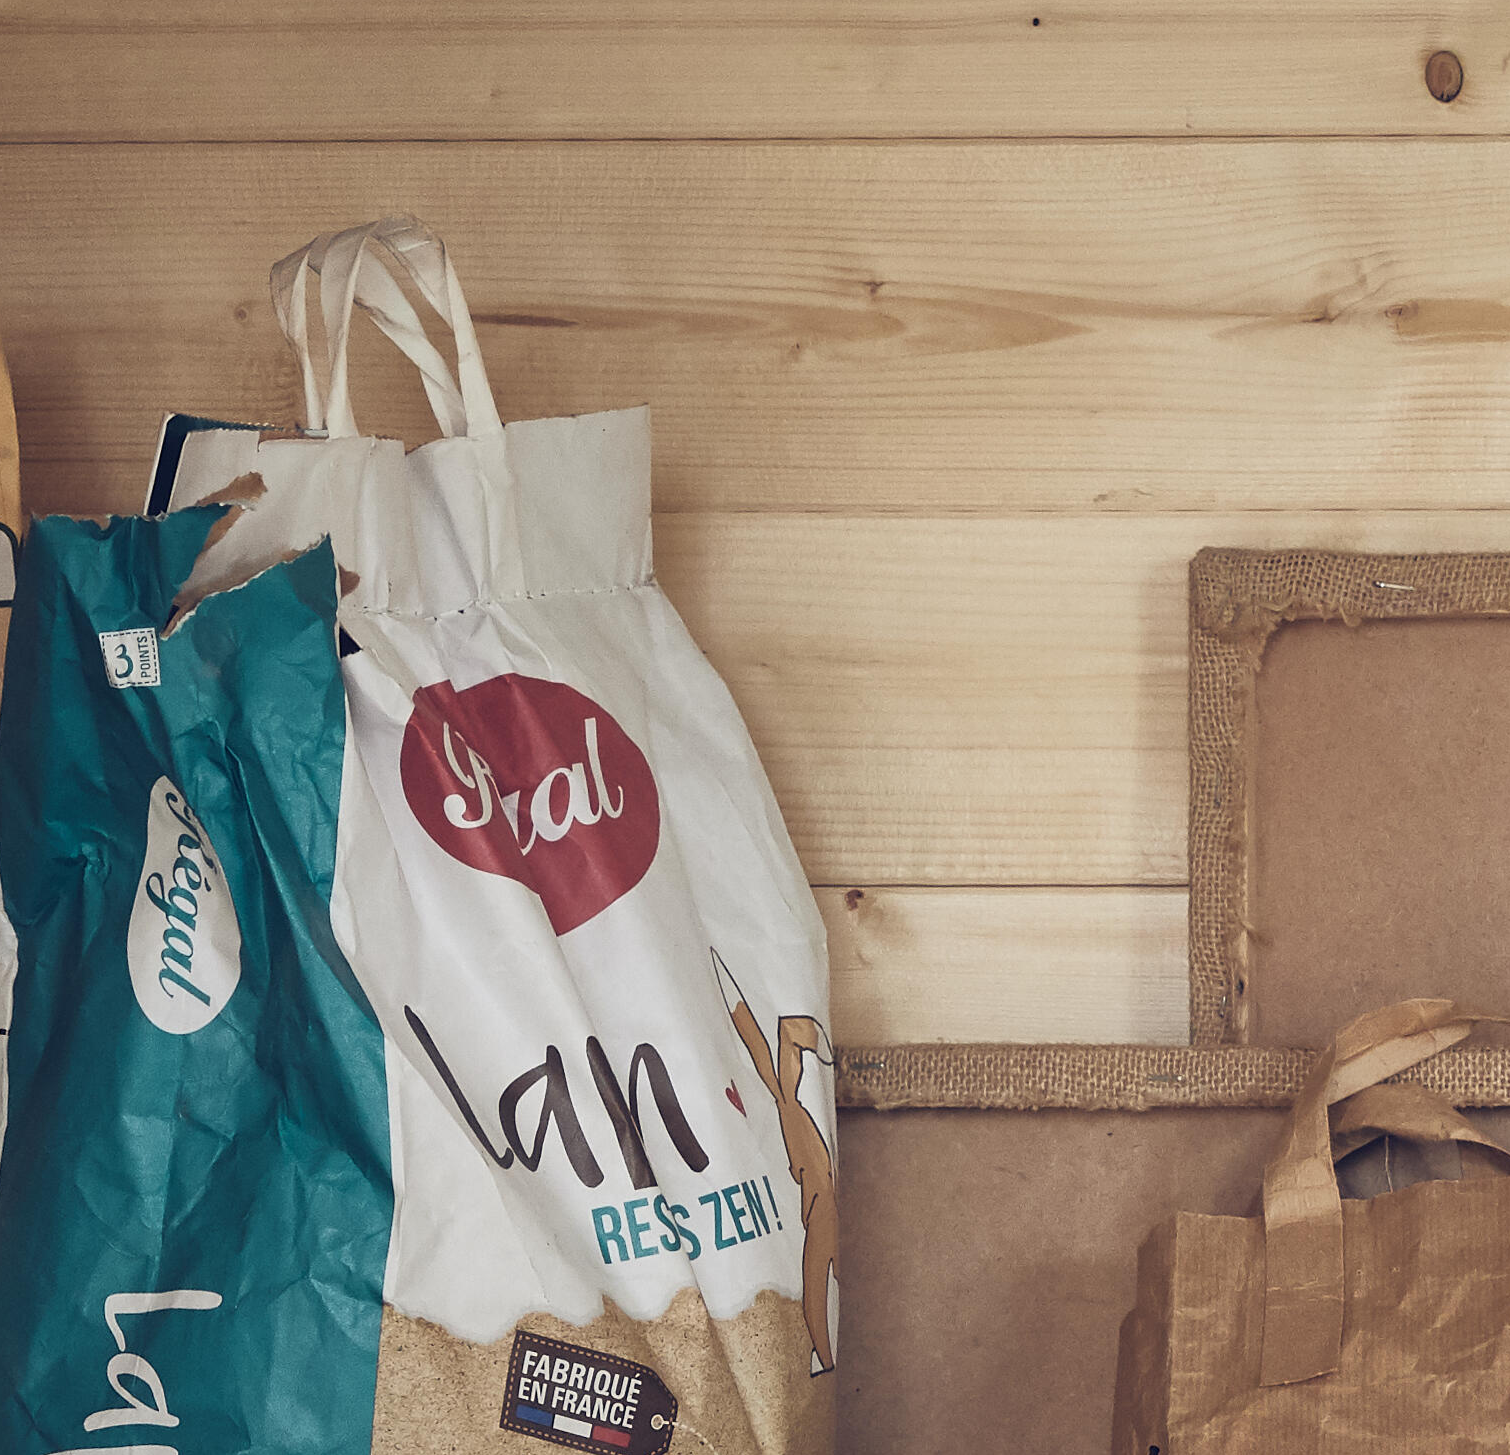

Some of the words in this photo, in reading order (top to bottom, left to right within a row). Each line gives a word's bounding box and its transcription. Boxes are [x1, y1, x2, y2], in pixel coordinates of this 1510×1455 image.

[114, 643, 133, 679] 3
[137, 636, 151, 678] POINTS
[146, 792, 217, 1007] Régal
[518, 1377, 547, 1405] EN
[551, 1387, 636, 1429] FRANCE
[521, 1350, 642, 1404] FABRIQUÉ
